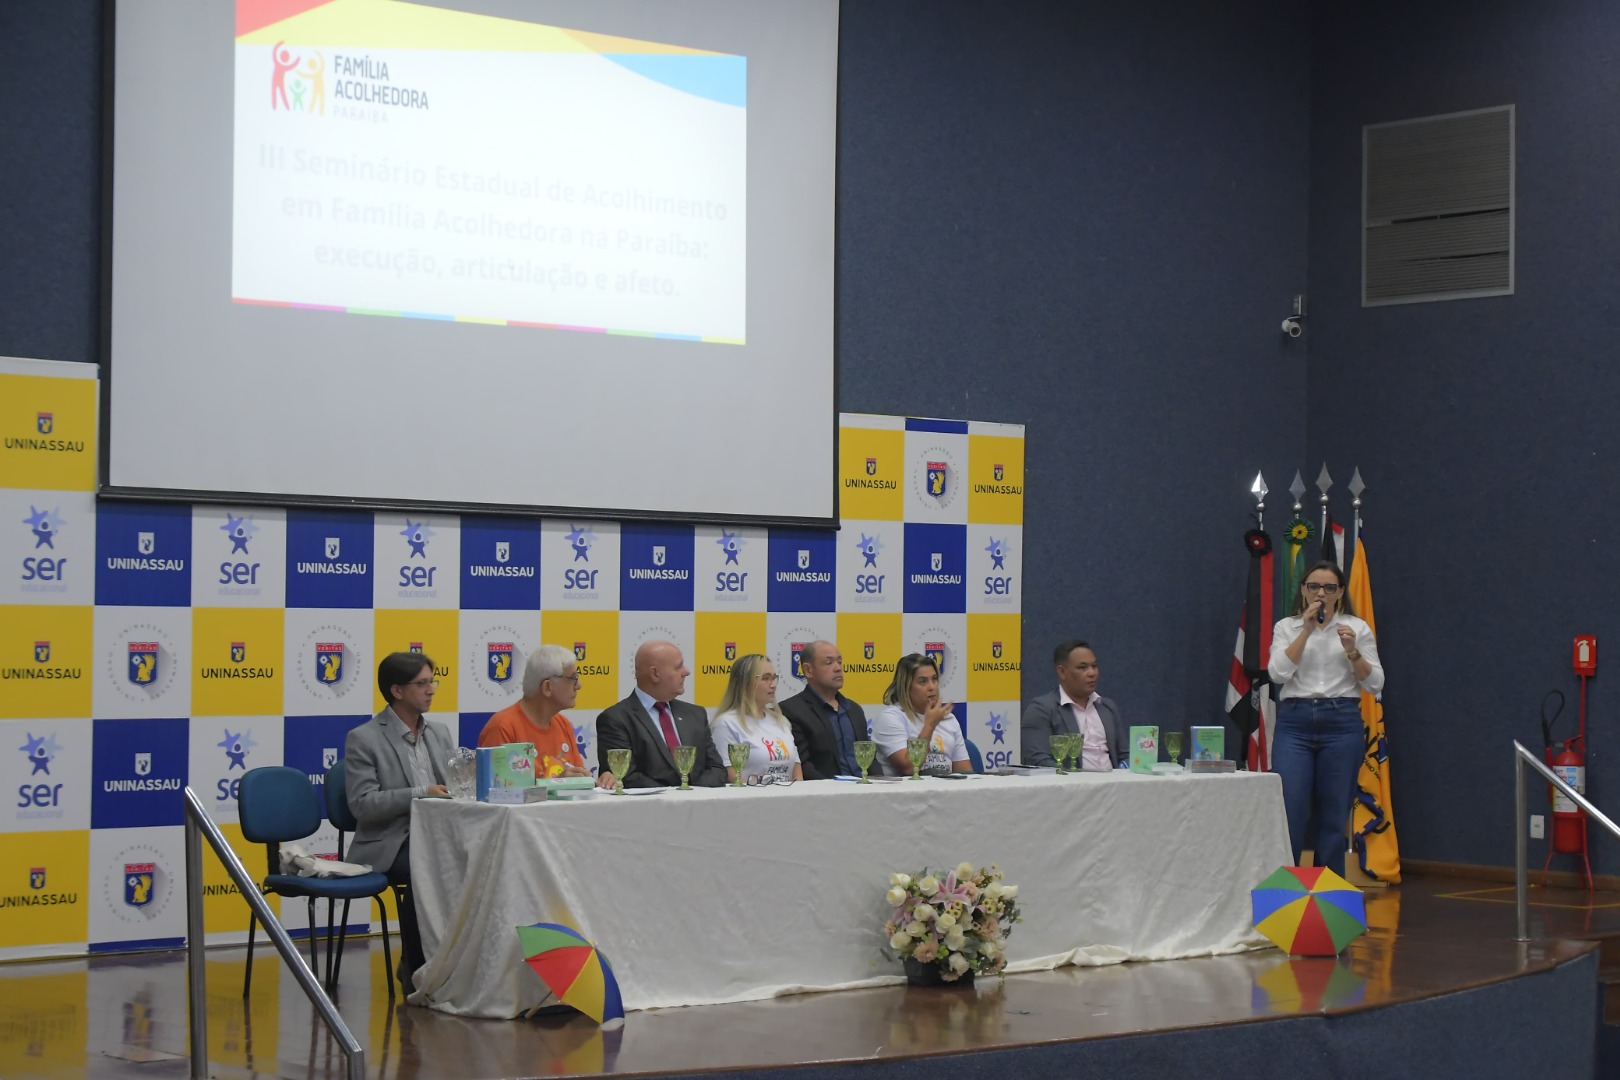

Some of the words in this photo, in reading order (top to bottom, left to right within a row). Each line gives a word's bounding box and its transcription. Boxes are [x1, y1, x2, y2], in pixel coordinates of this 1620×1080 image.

[334, 55, 389, 82] FAMÍLIA
[334, 82, 429, 111] ACOLHEDORA
[258, 143, 286, 171] III
[293, 148, 427, 188] Seminário
[435, 165, 540, 200] Estadual
[547, 175, 576, 203] de
[583, 183, 728, 222] Acolhimento
[281, 196, 323, 219] em
[331, 195, 426, 230] Família
[433, 208, 574, 246] Acolhedora
[580, 226, 609, 249] na
[616, 229, 709, 260] Paraíba:
[314, 244, 444, 278] execução,
[451, 254, 588, 292] articulação
[595, 270, 609, 290] e
[615, 270, 681, 298] afeto.
[5, 437, 84, 453] UNINASSAU
[846, 478, 897, 490] UNINASSAU
[975, 484, 1022, 496] UNINASSAU
[22, 557, 67, 580] ser
[108, 556, 184, 571] UNINASSAU
[298, 562, 367, 575] UNINASSAU
[471, 566, 534, 577] UNINASSAU
[219, 562, 260, 584] ser
[399, 566, 436, 587] ser
[564, 569, 598, 589] ser
[630, 569, 688, 580] UNINASSAU
[777, 572, 830, 583] UNINASSAU
[911, 575, 961, 585] UNINASSAU
[716, 572, 747, 591] ser
[856, 575, 885, 593] ser
[985, 577, 1011, 594] ser
[2, 667, 82, 680] UNINASSAU
[202, 668, 273, 679] UNINASSAU
[843, 663, 895, 673] UNINASSAU
[974, 661, 1021, 672] UNINASSAU
[104, 776, 180, 792] UNINASSAU
[216, 779, 239, 801] se
[18, 784, 63, 807] ser
